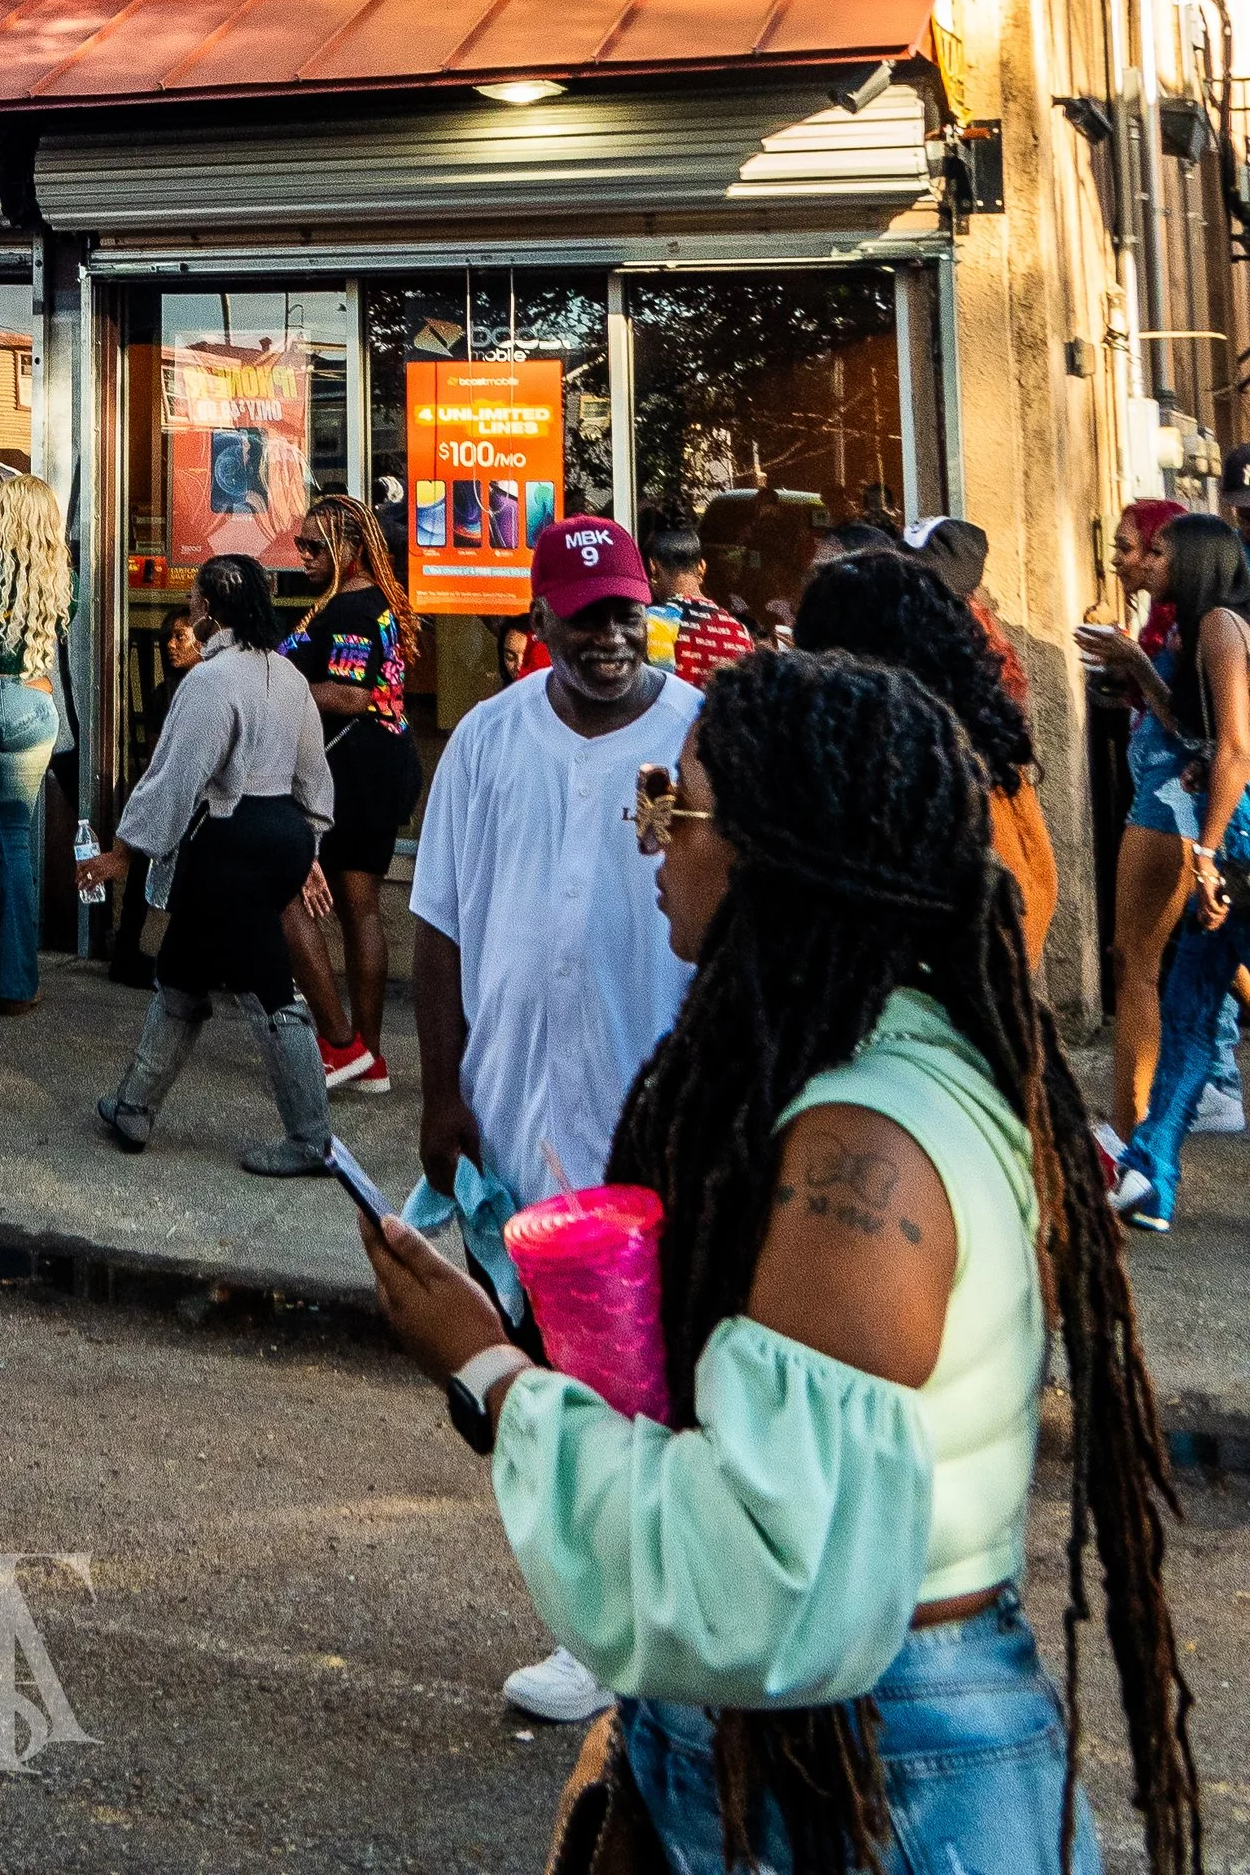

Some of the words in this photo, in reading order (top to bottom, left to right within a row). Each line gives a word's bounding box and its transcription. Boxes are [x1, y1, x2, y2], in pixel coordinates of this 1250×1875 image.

[417, 408, 434, 422] 4
[438, 407, 551, 422] UNLIMITED
[477, 421, 539, 435] LINES
[438, 440, 527, 469] $100/MO
[565, 529, 614, 550] MBK
[581, 546, 600, 567] 9
